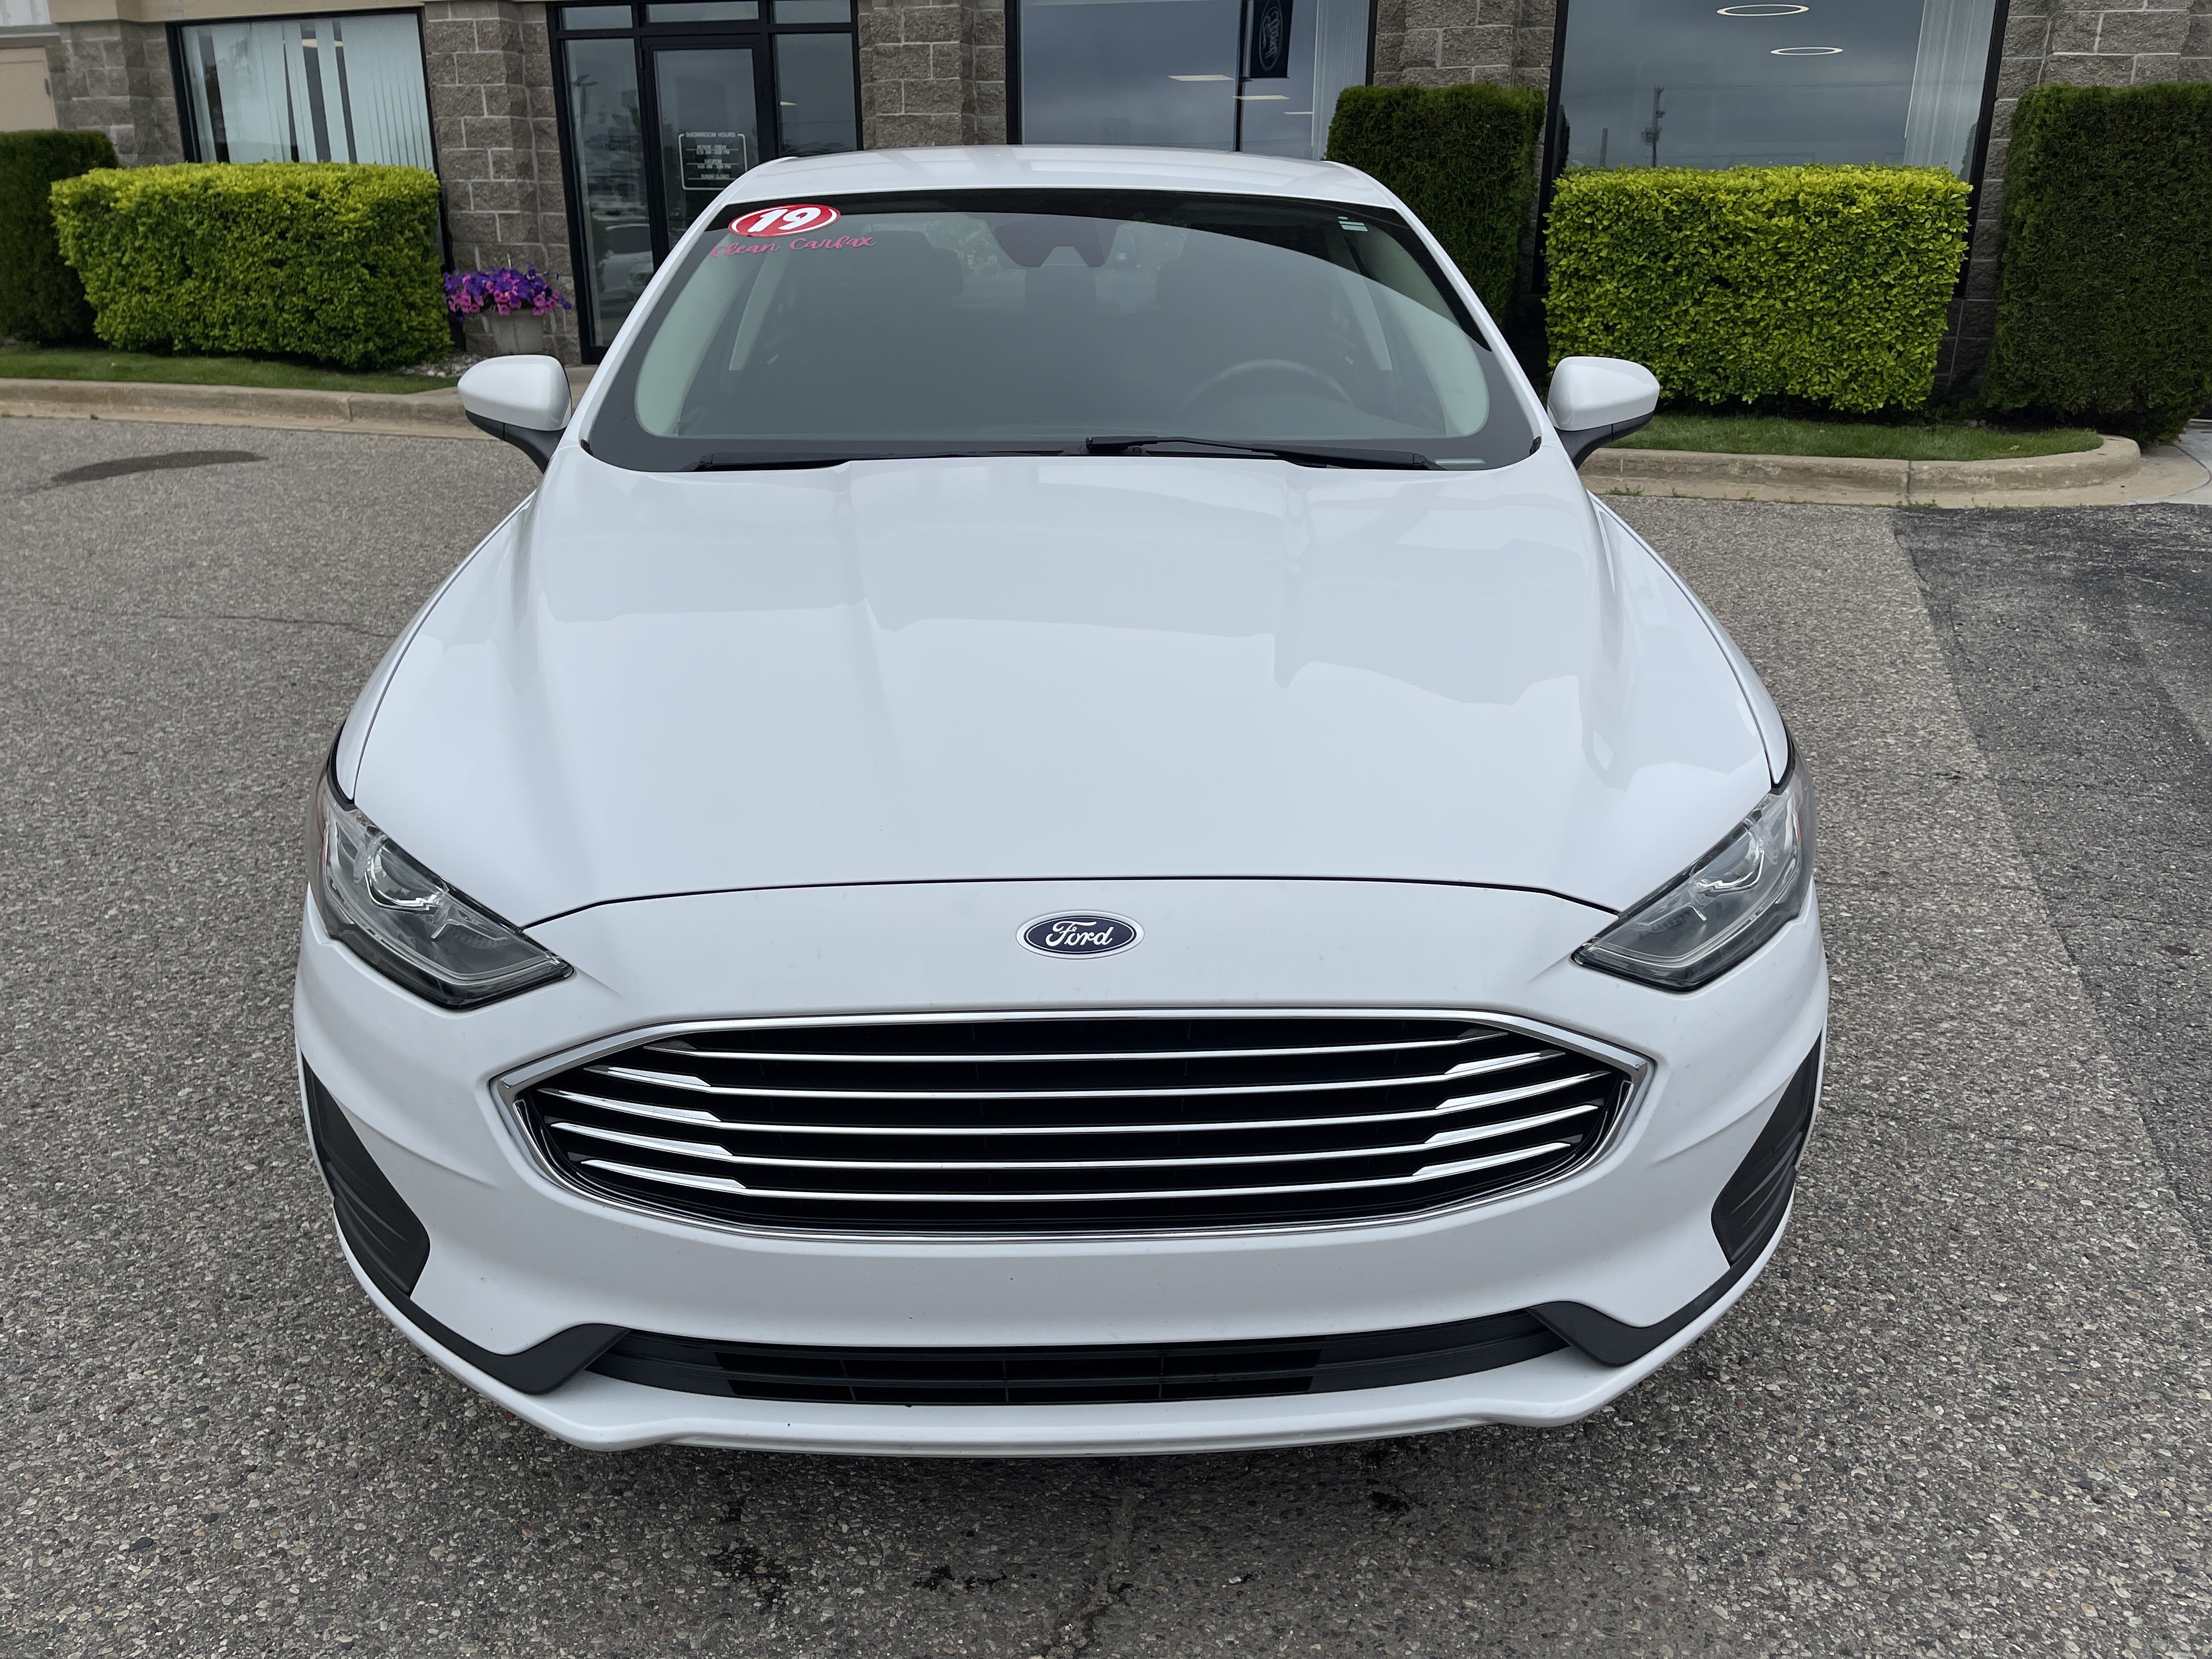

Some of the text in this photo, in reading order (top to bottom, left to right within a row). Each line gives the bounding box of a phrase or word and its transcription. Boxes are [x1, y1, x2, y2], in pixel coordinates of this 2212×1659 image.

[747, 207, 821, 233] 19
[711, 235, 877, 257] Clean Carfax
[1045, 921, 1113, 947] Ford
